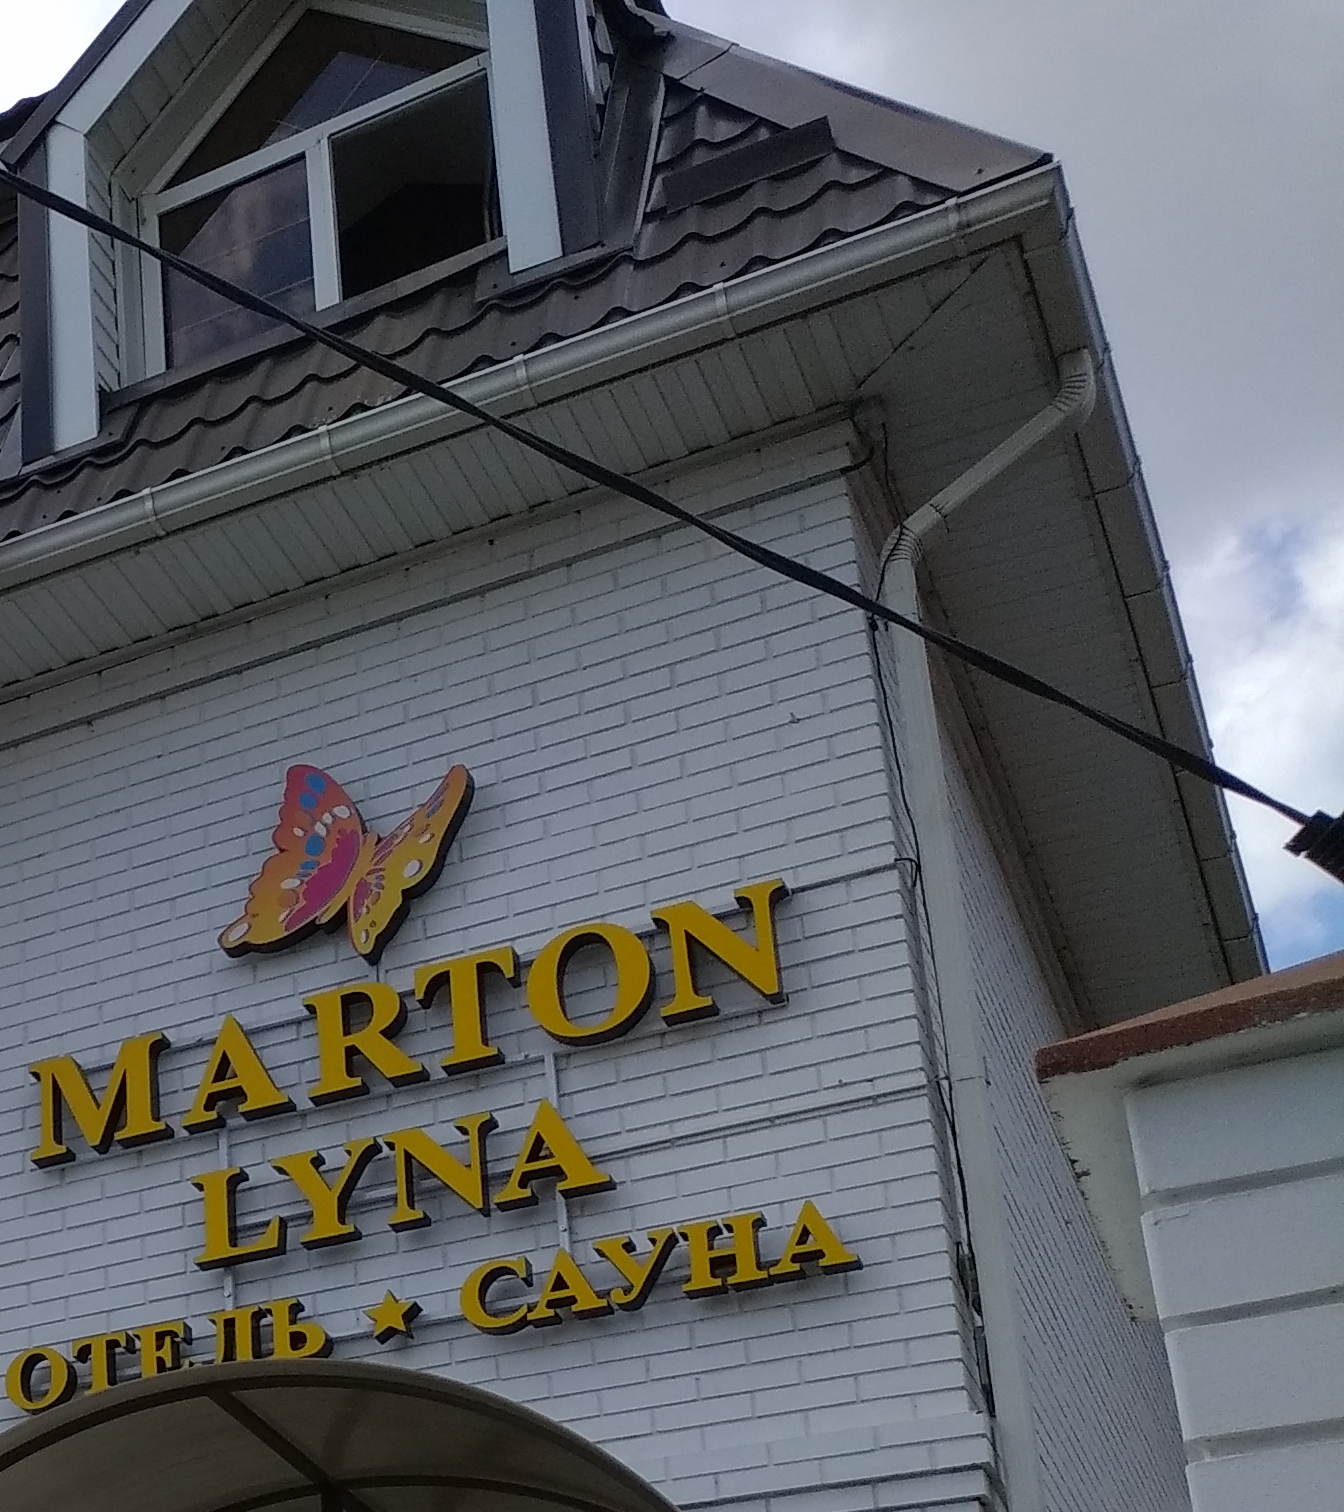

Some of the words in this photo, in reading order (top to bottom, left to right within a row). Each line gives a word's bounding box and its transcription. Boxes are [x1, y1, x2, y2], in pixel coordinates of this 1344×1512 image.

[28, 879, 793, 1170] MARTON
[191, 1098, 616, 1270] LYNA
[5, 1298, 333, 1414] ОТЕЛЬ
[460, 1200, 862, 1335] САУНА
